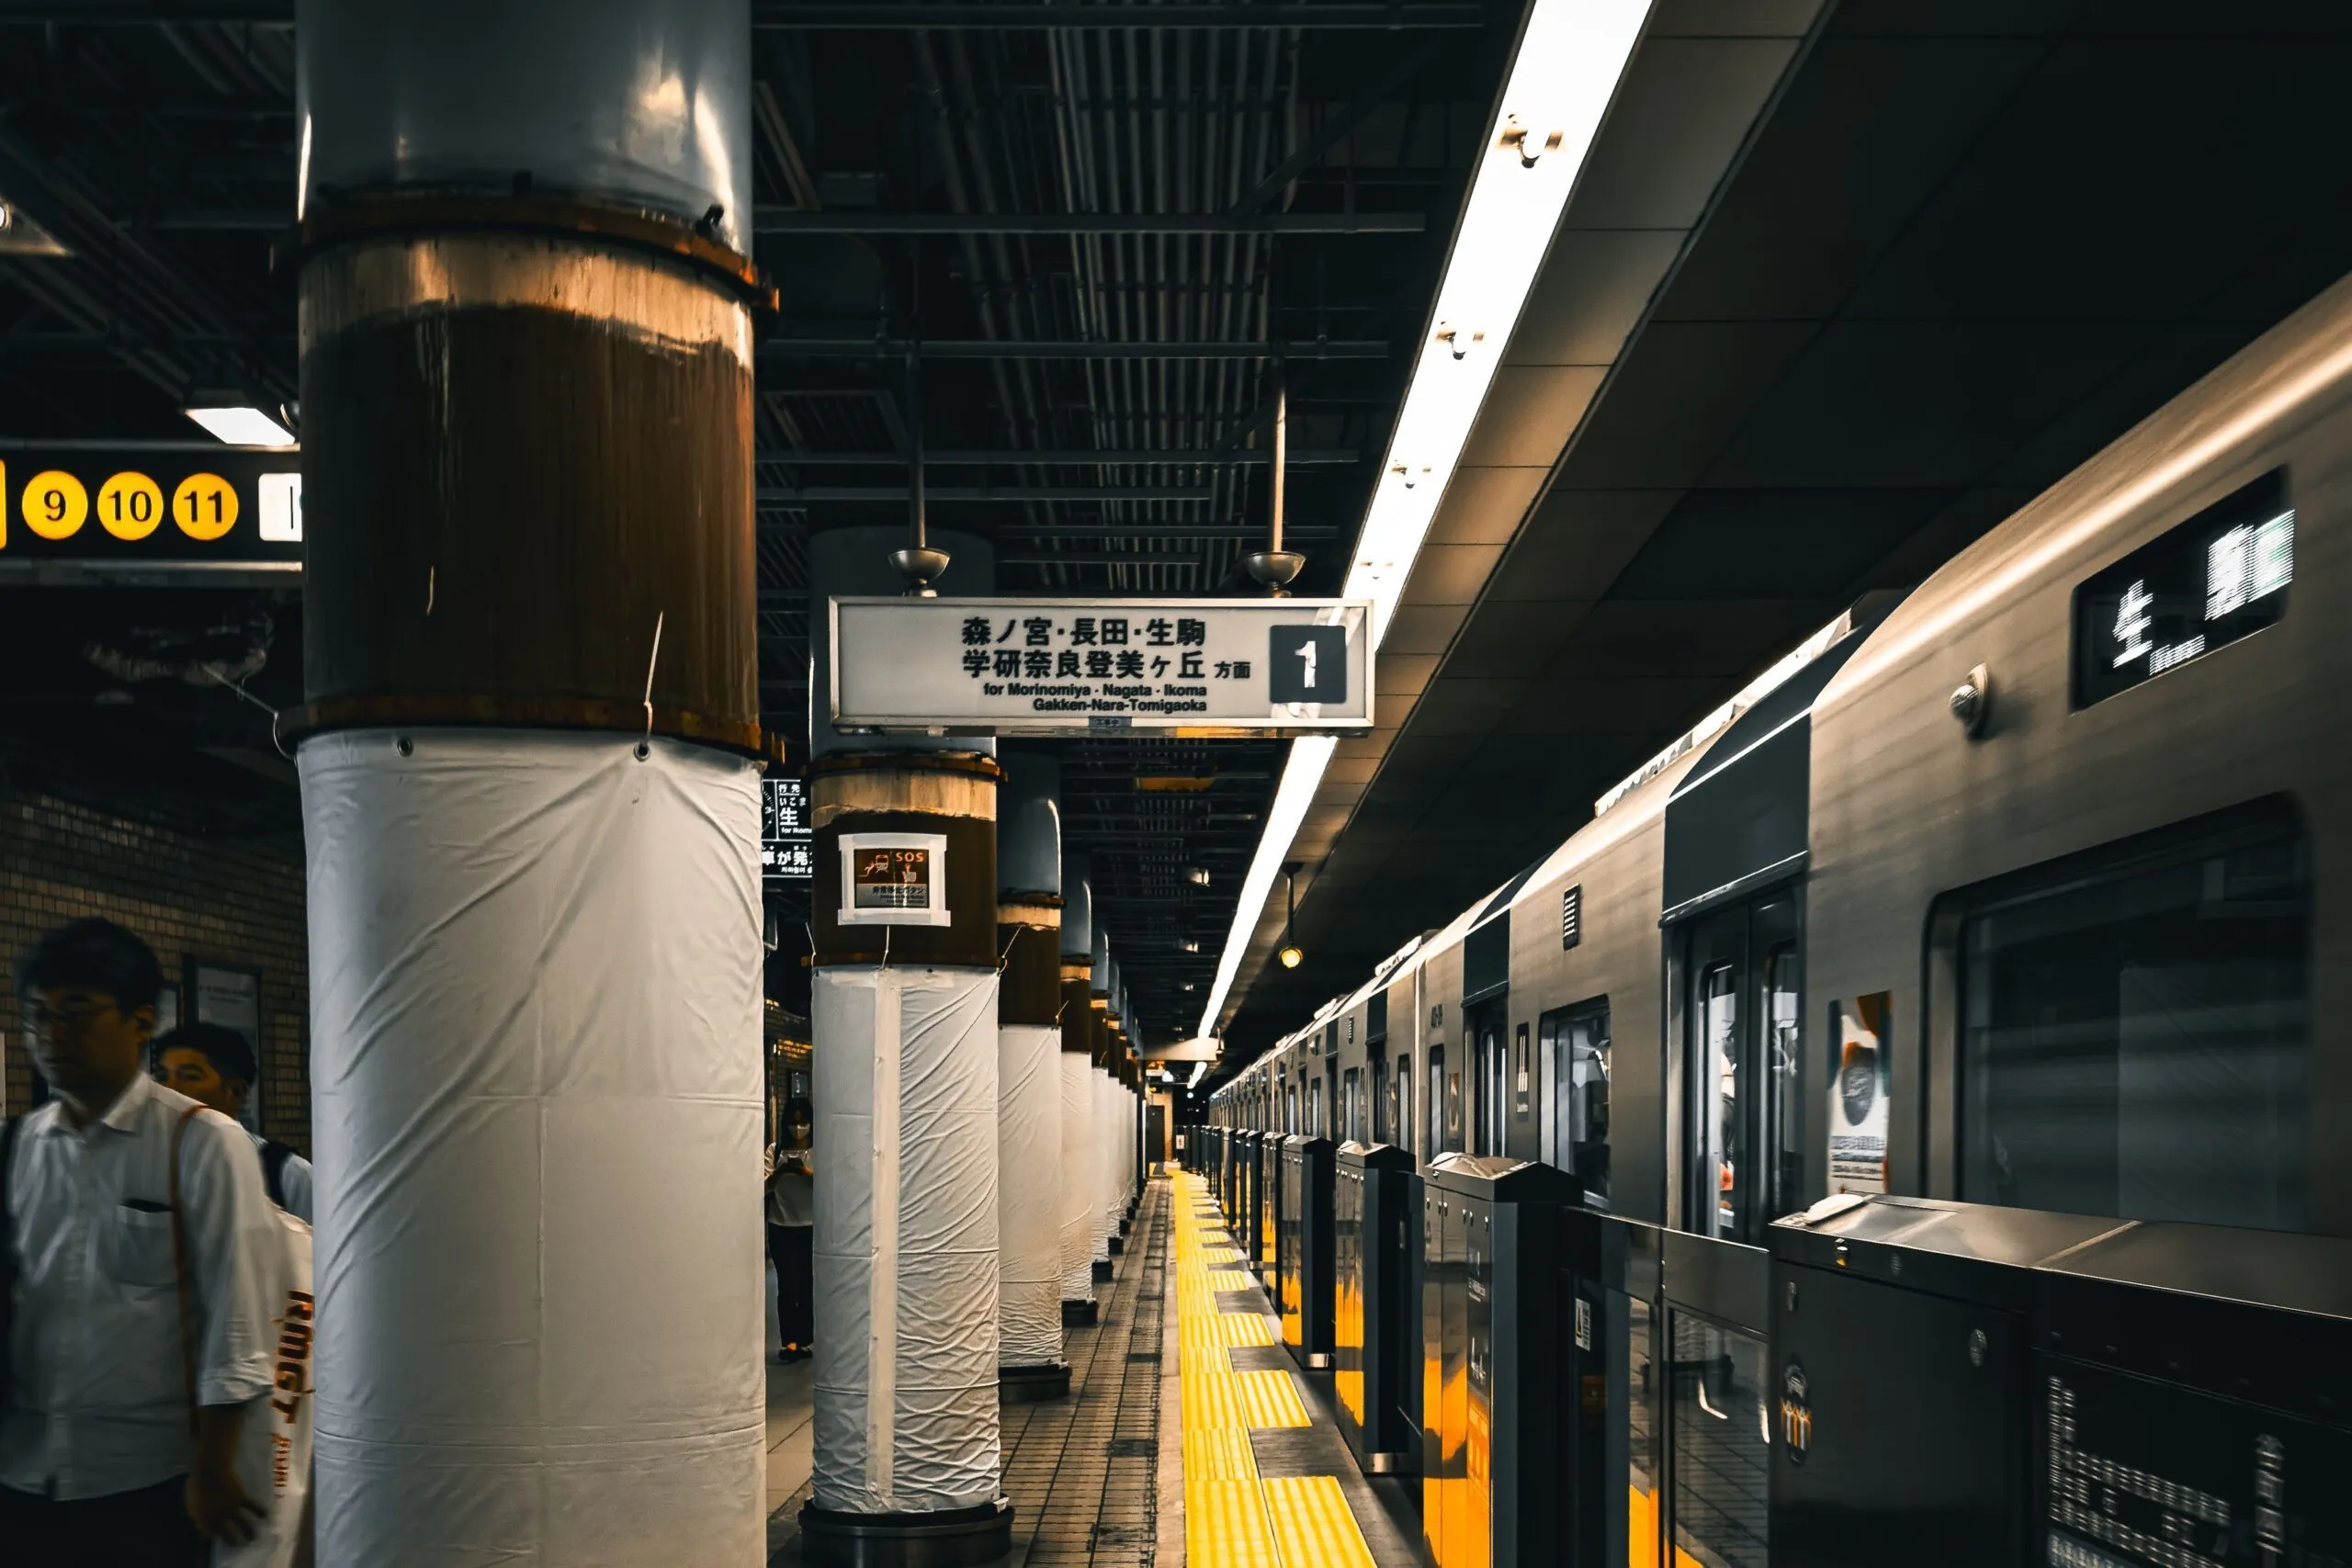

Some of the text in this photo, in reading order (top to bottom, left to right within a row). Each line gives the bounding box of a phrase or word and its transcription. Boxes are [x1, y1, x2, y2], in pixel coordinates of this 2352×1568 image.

[43, 490, 222, 524] 9 10 11
[961, 615, 1206, 648] 森ノ宮・長田・生駒
[1214, 660, 1251, 680] 方面
[1295, 640, 1317, 689] 1
[983, 682, 1207, 699] for Morinomiya Nagata Ikoma
[1032, 697, 1207, 714] Gakken-Nara-Tomigaoka
[896, 852, 925, 863] SOS
